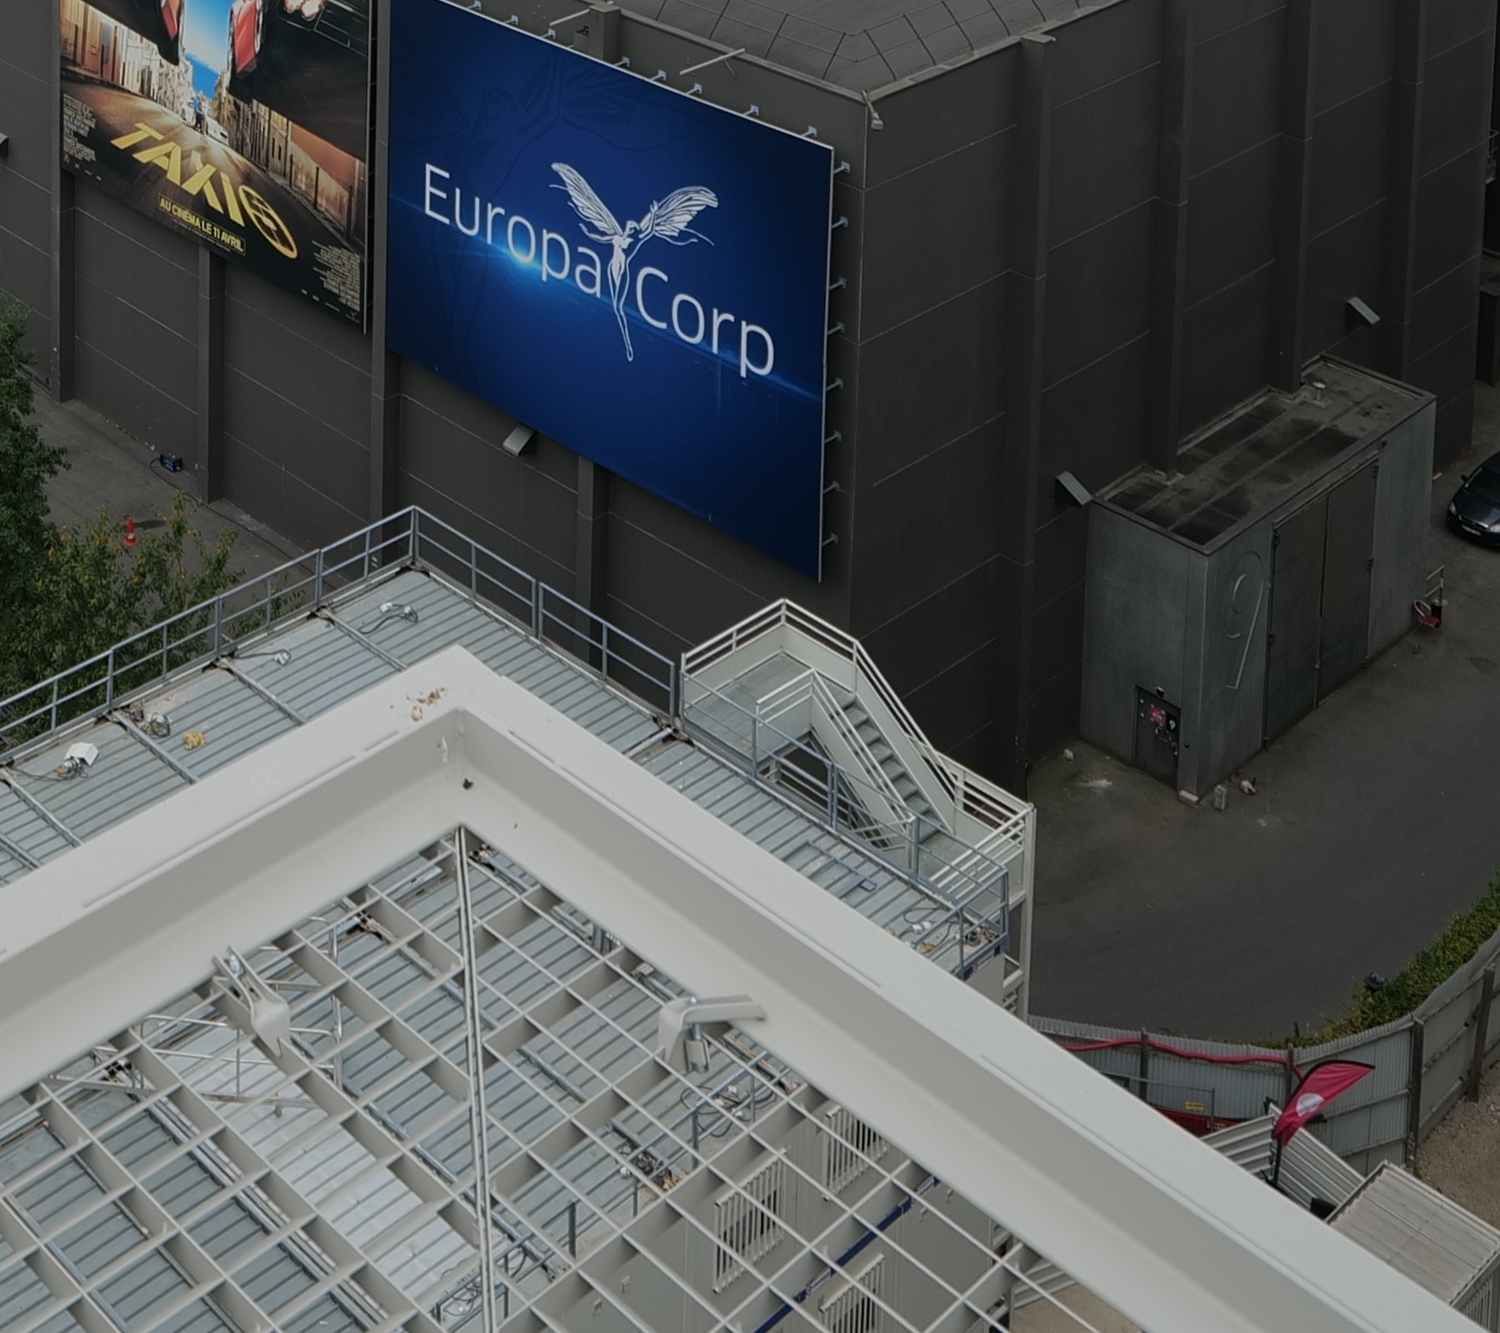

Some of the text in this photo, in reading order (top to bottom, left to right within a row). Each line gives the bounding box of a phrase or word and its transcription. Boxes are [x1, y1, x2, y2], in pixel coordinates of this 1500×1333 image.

[160, 198, 172, 212] AU
[201, 220, 212, 235] LE
[213, 226, 220, 239] 11
[221, 231, 244, 252] AVRIL
[424, 163, 600, 297] Europa
[635, 266, 775, 377] Corp
